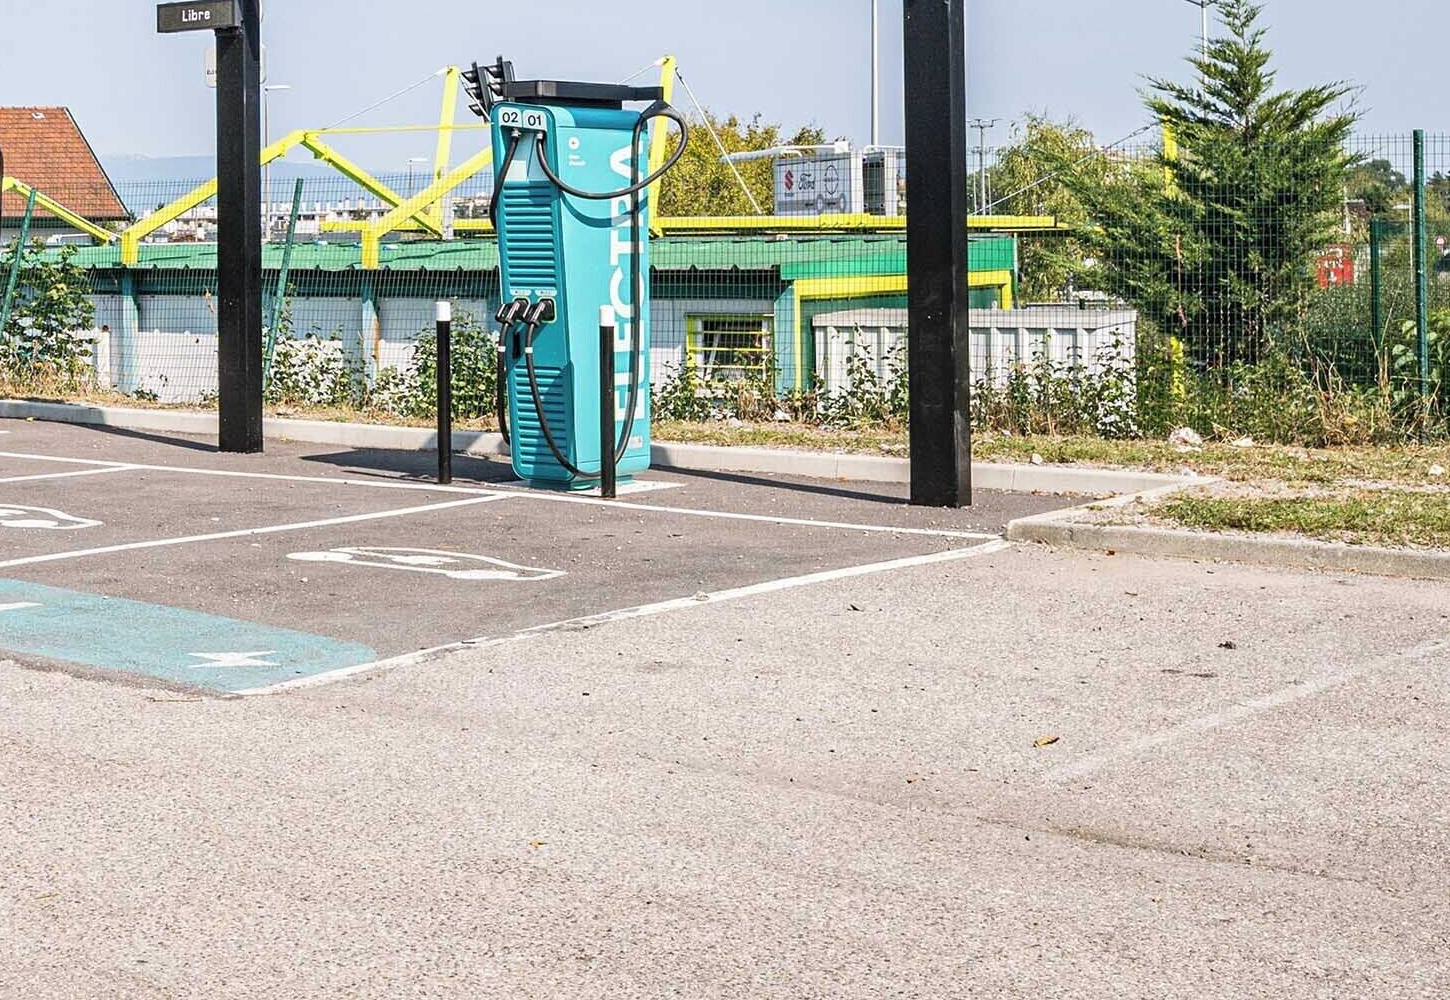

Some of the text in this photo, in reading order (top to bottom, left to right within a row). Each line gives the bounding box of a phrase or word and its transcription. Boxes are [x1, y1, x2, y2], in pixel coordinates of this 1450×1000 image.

[181, 8, 211, 22] Libre
[502, 111, 519, 123] 02
[527, 114, 543, 126] 01
[610, 142, 645, 422] ELECTRA
